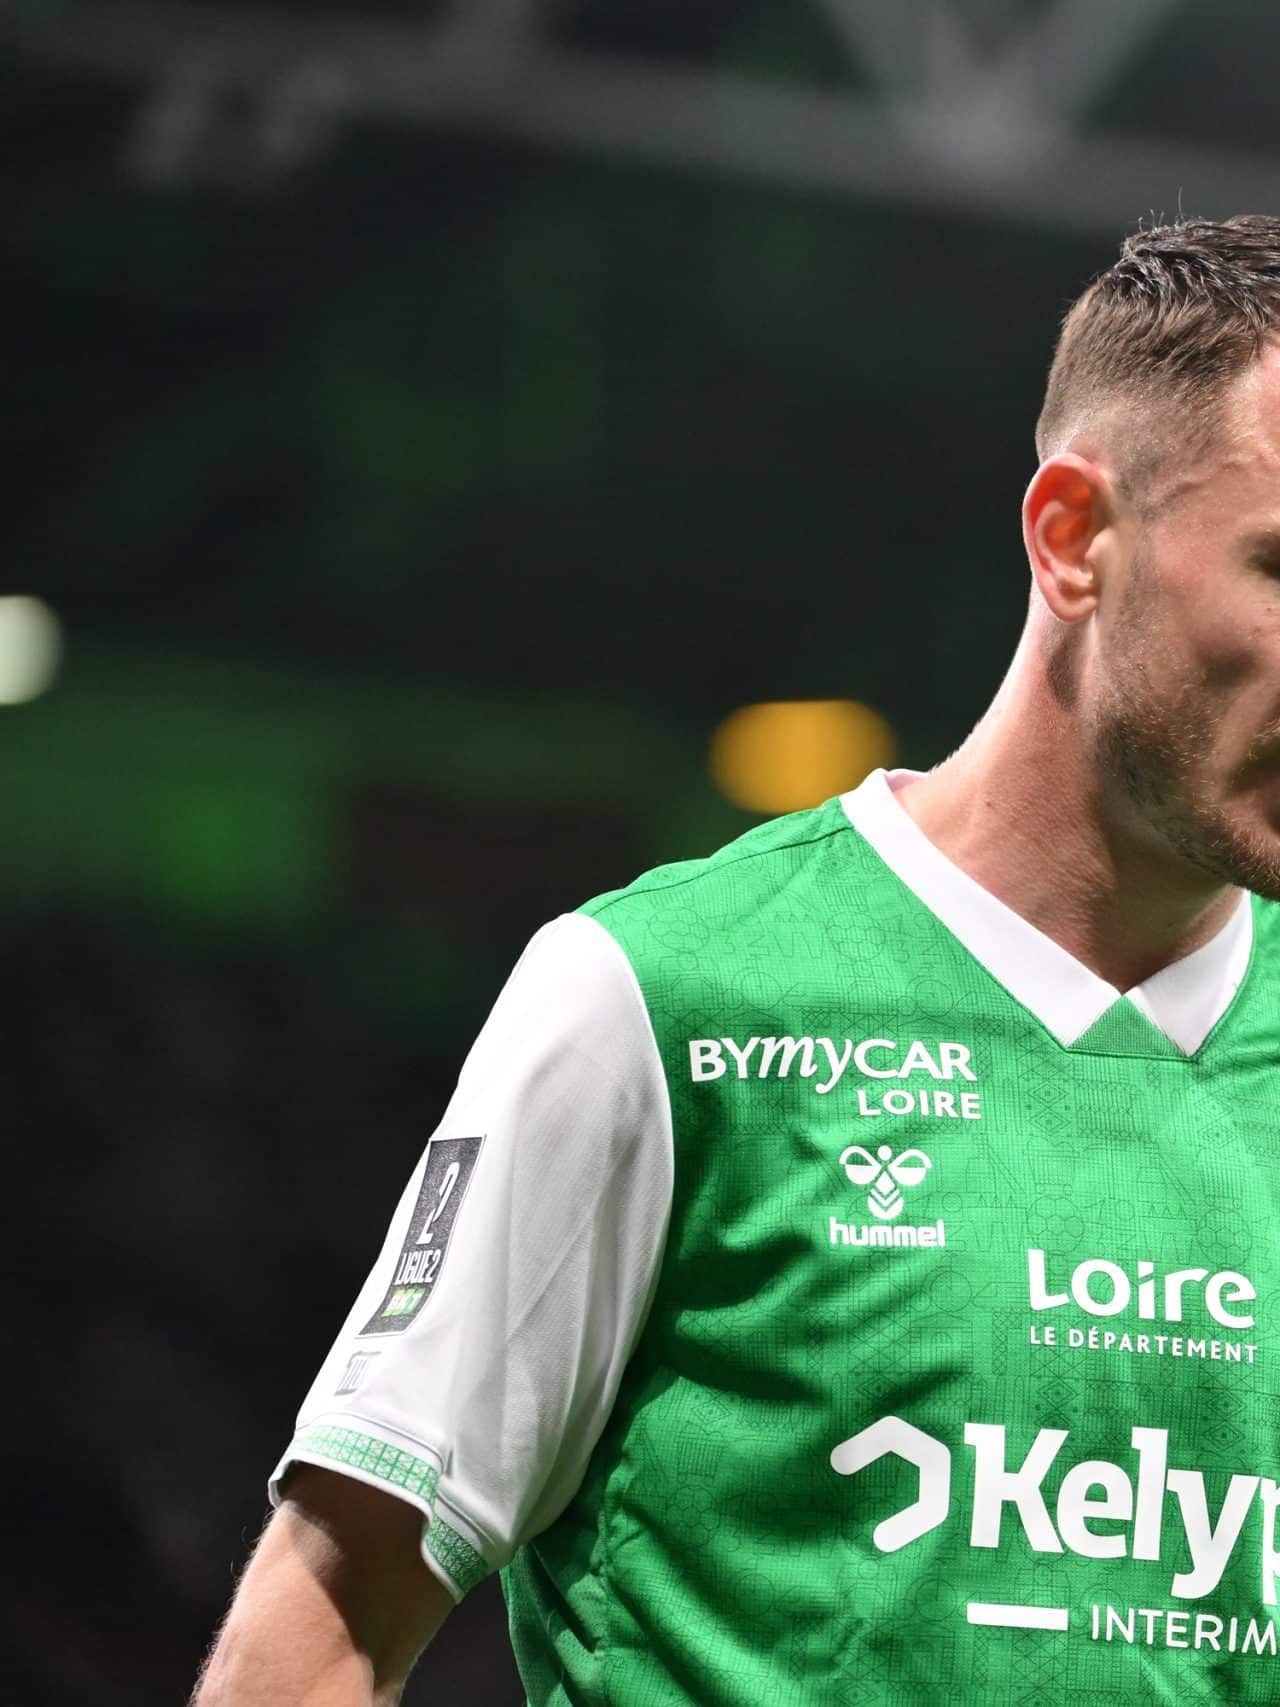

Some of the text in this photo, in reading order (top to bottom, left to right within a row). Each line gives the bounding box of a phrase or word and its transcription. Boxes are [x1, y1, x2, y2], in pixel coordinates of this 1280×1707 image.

[689, 1036, 977, 1094] BYmyCAR
[857, 1089, 981, 1120] LOIRE
[415, 1161, 461, 1246] 2
[829, 1216, 945, 1248] hummel
[1030, 1325, 1258, 1364] LE DÉPARTEMENT
[1091, 1604, 1278, 1656] INTERIM
